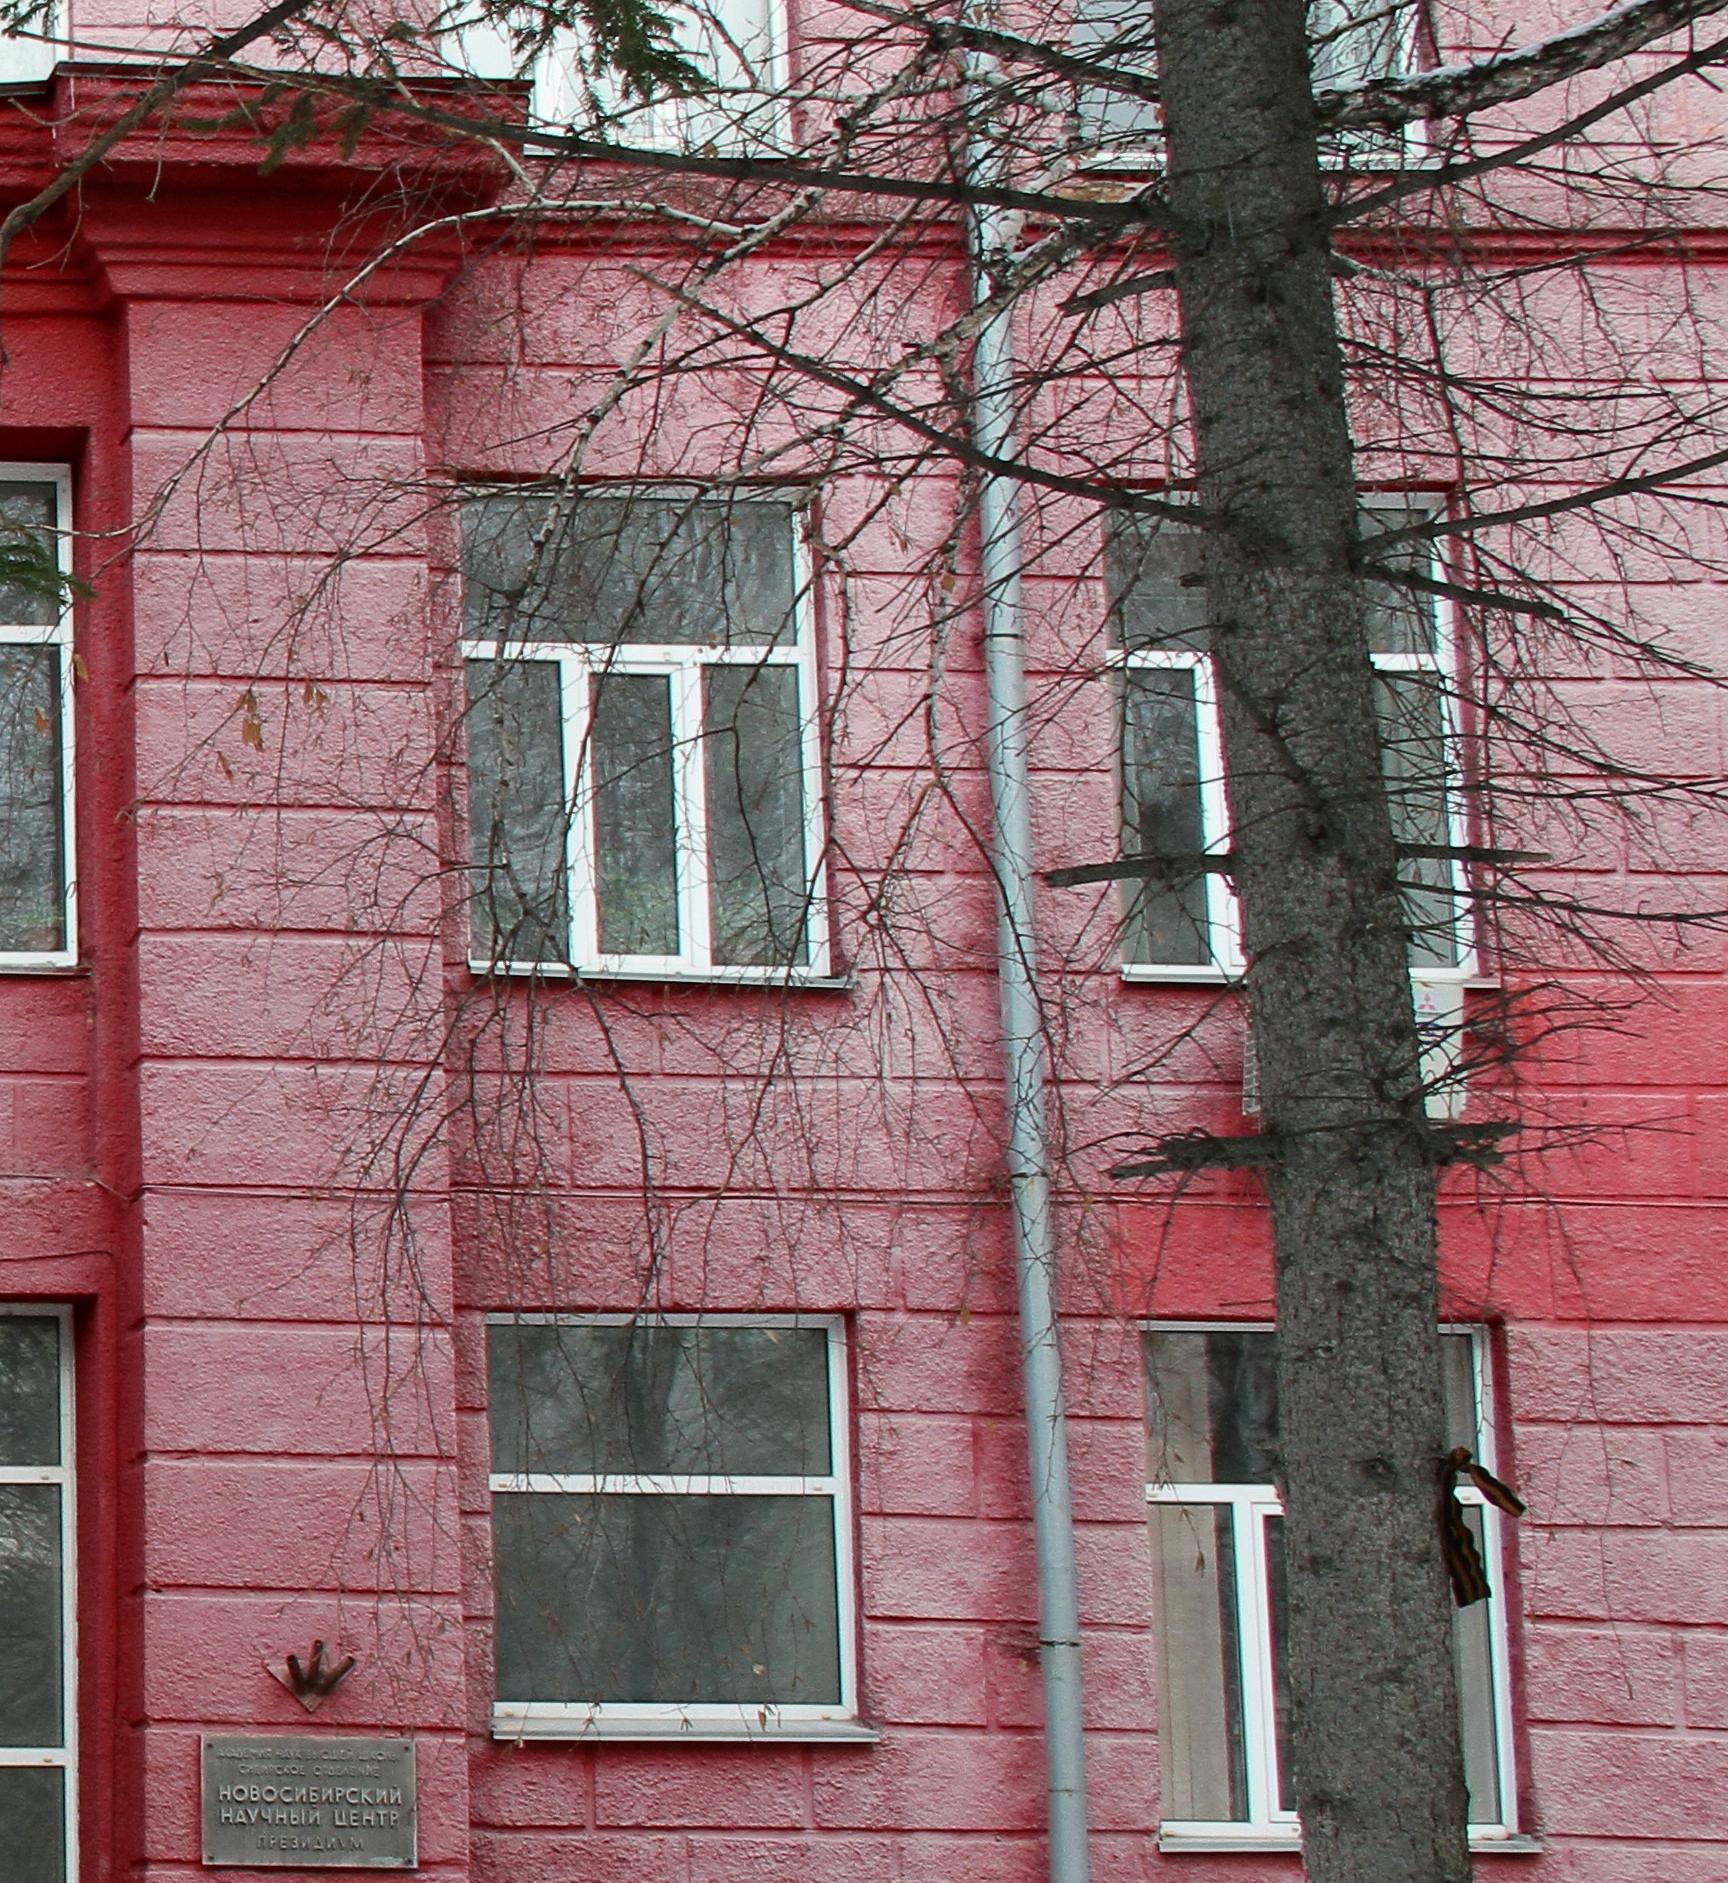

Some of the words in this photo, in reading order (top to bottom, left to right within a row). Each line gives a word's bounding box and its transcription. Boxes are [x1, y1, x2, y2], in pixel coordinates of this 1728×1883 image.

[217, 1785, 404, 1807] НОВОСИБИРСКИЙ
[220, 1806, 321, 1828] НАУЧНЫЙ
[334, 1810, 402, 1829] ЦЕНТР
[257, 1836, 366, 1852] ПРЕЗИДИУМ
